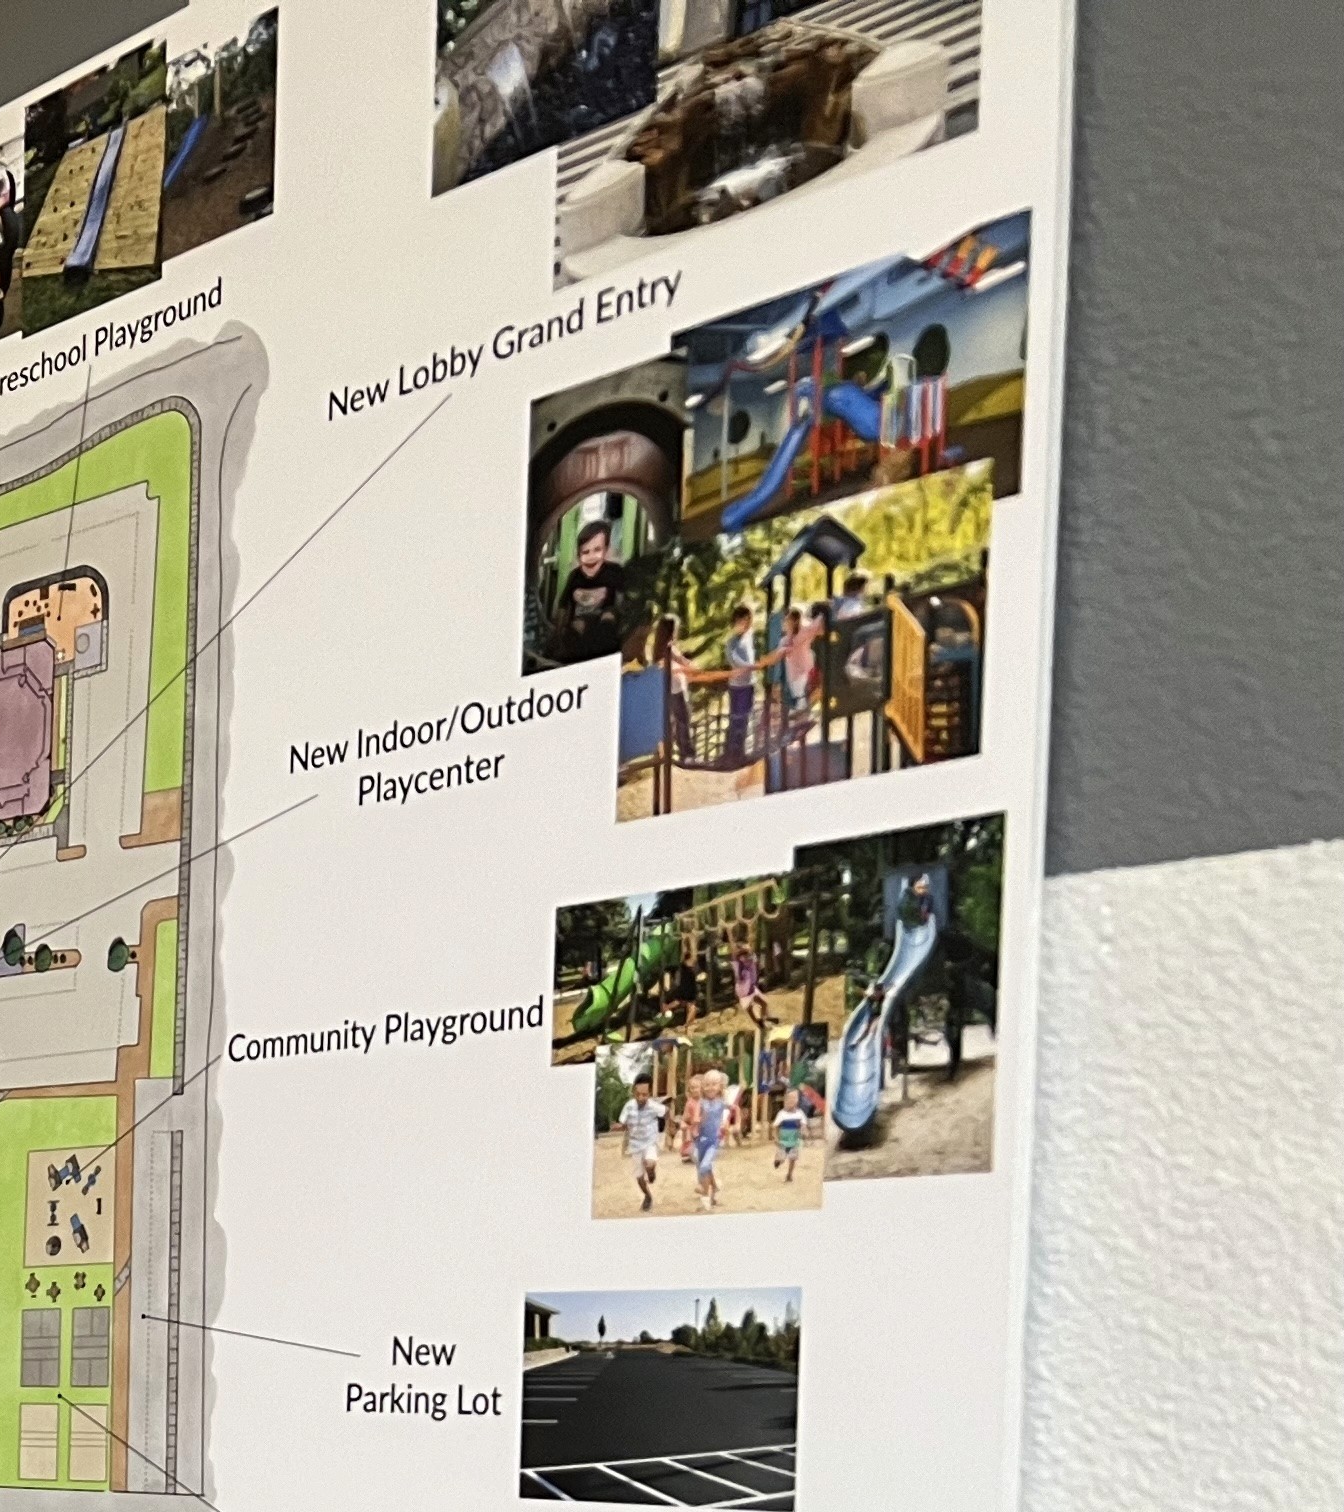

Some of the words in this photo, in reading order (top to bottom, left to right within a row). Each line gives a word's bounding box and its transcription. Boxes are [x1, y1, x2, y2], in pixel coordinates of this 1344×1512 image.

[93, 277, 223, 356] Playground
[327, 381, 390, 422] New
[396, 341, 484, 397] Lobby
[493, 303, 584, 360] Grand
[596, 269, 684, 325] Entry
[290, 740, 349, 774] New
[357, 683, 589, 759] Indoor/Outdoor
[358, 753, 506, 806] Playcenter
[228, 1019, 377, 1063] Community
[385, 995, 544, 1049] Playground
[392, 1335, 457, 1367] New
[346, 1383, 447, 1422] Parking
[457, 1385, 502, 1416] Lot
